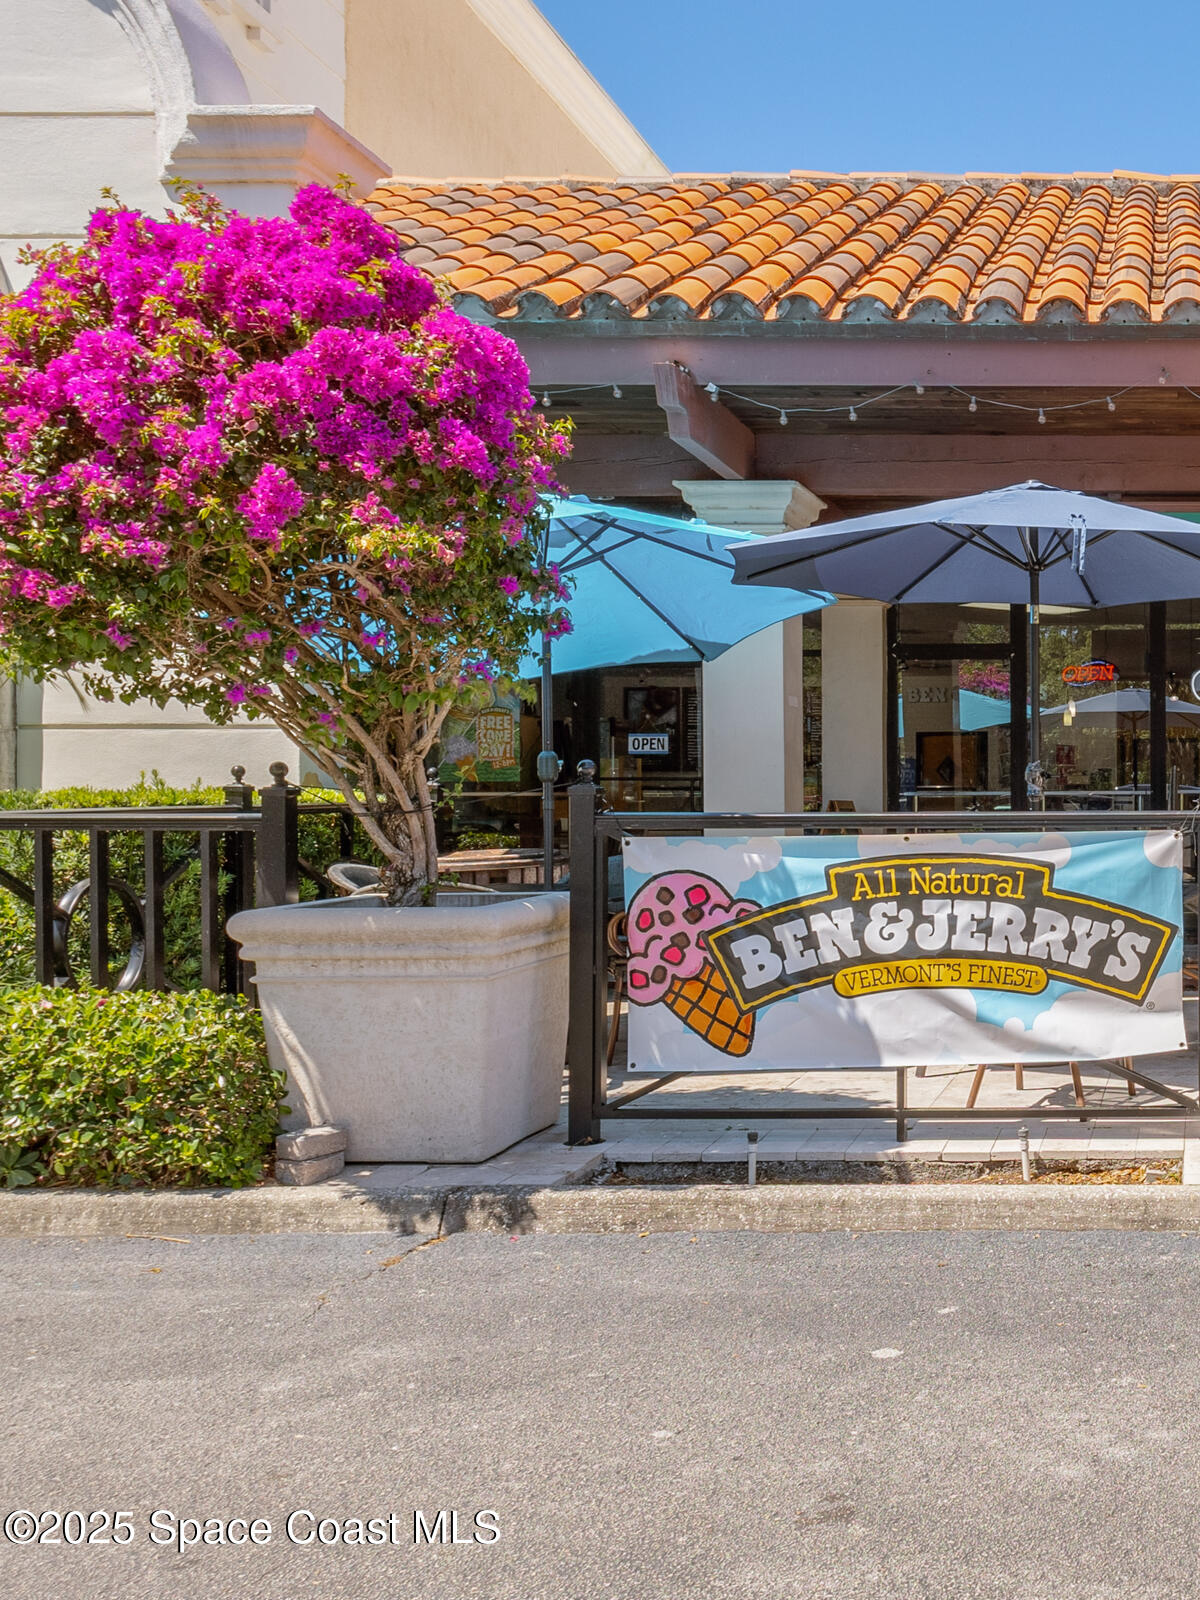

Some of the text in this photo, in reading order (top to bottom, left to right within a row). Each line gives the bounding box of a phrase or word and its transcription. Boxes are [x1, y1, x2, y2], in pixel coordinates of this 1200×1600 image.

[1062, 663, 1115, 682] OPEN
[480, 715, 511, 729] FREE
[632, 737, 665, 750] OPEN
[851, 866, 1026, 901] All Natural
[842, 963, 1038, 992] VERMONT'S FINEST
